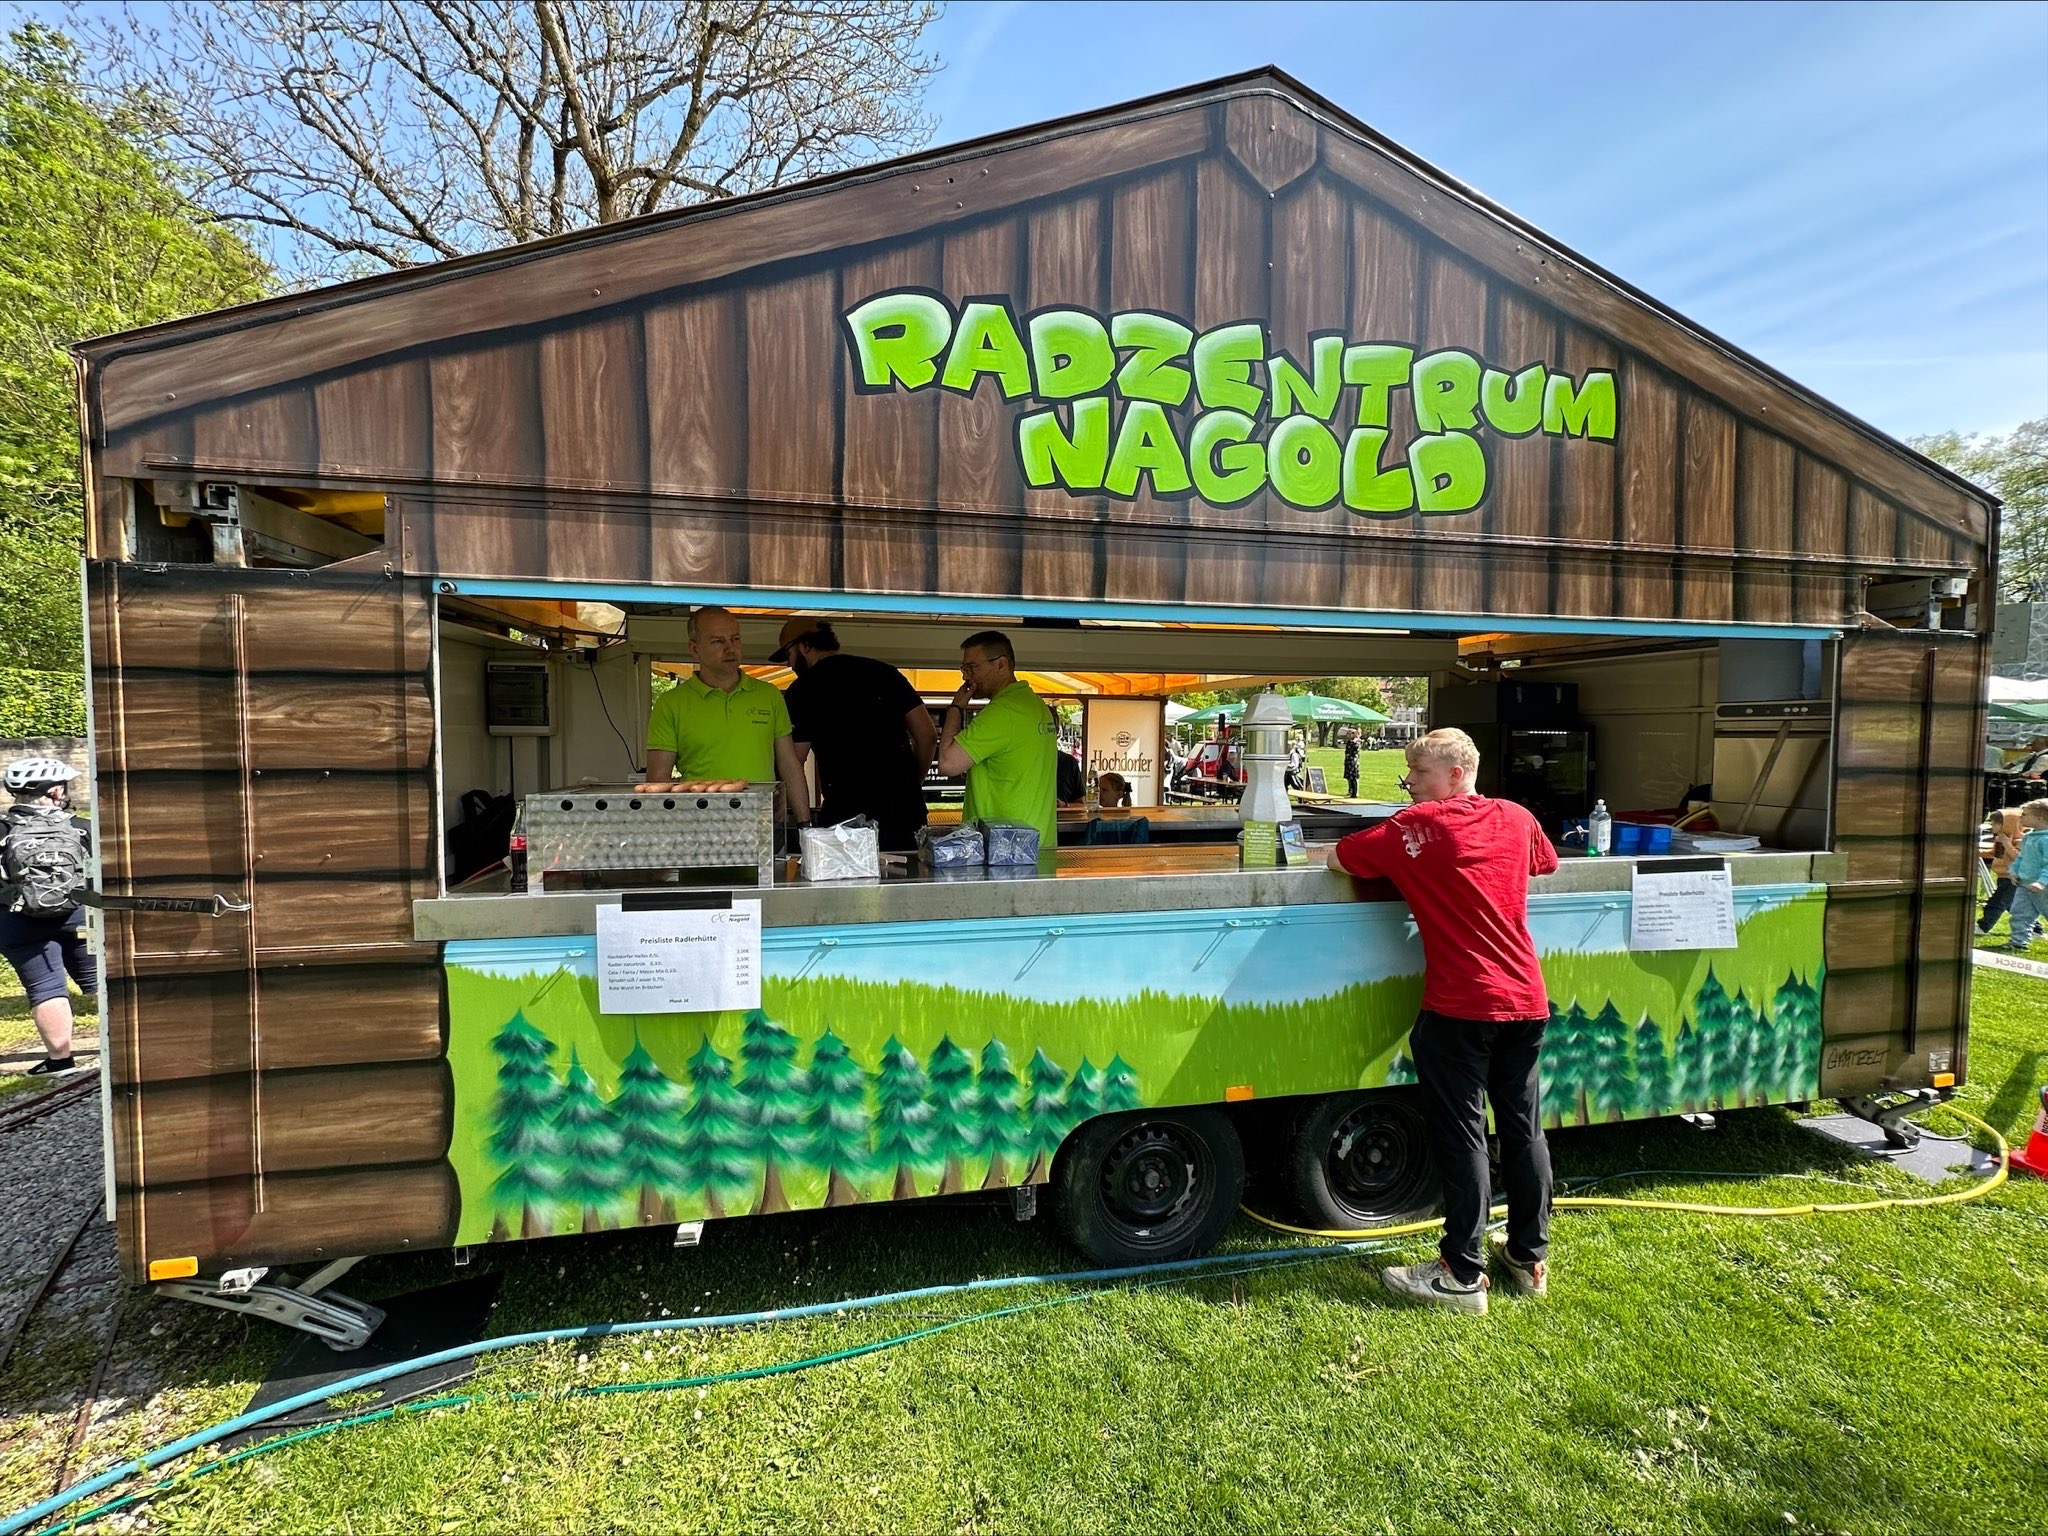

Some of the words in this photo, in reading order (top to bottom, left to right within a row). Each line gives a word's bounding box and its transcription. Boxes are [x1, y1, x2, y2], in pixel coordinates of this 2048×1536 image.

[842, 287, 1618, 442] RADZENTRUM
[1015, 395, 1491, 518] NAGOLD
[1093, 749, 1153, 772] Hochdorfer
